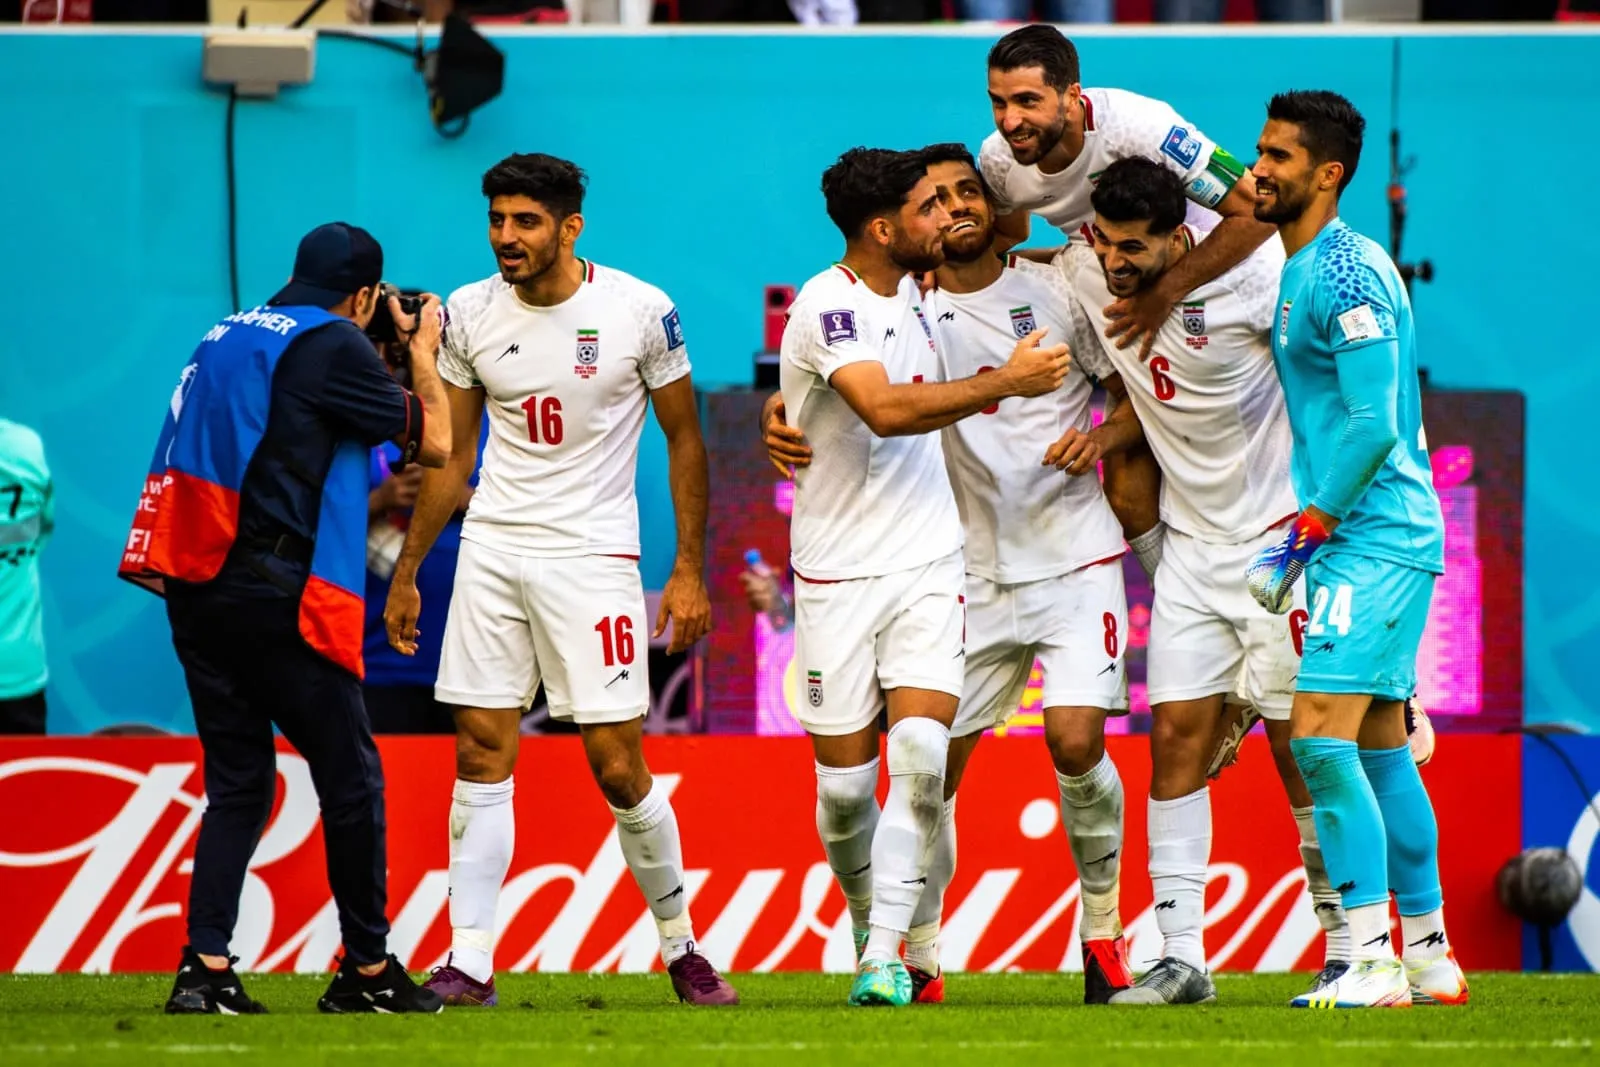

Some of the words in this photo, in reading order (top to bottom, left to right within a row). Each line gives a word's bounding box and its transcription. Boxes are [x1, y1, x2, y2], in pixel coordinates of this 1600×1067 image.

[1150, 356, 1176, 401] 6
[521, 395, 564, 446] 16
[1103, 611, 1118, 659] 8
[1308, 584, 1353, 637] 24
[594, 614, 635, 667] 16
